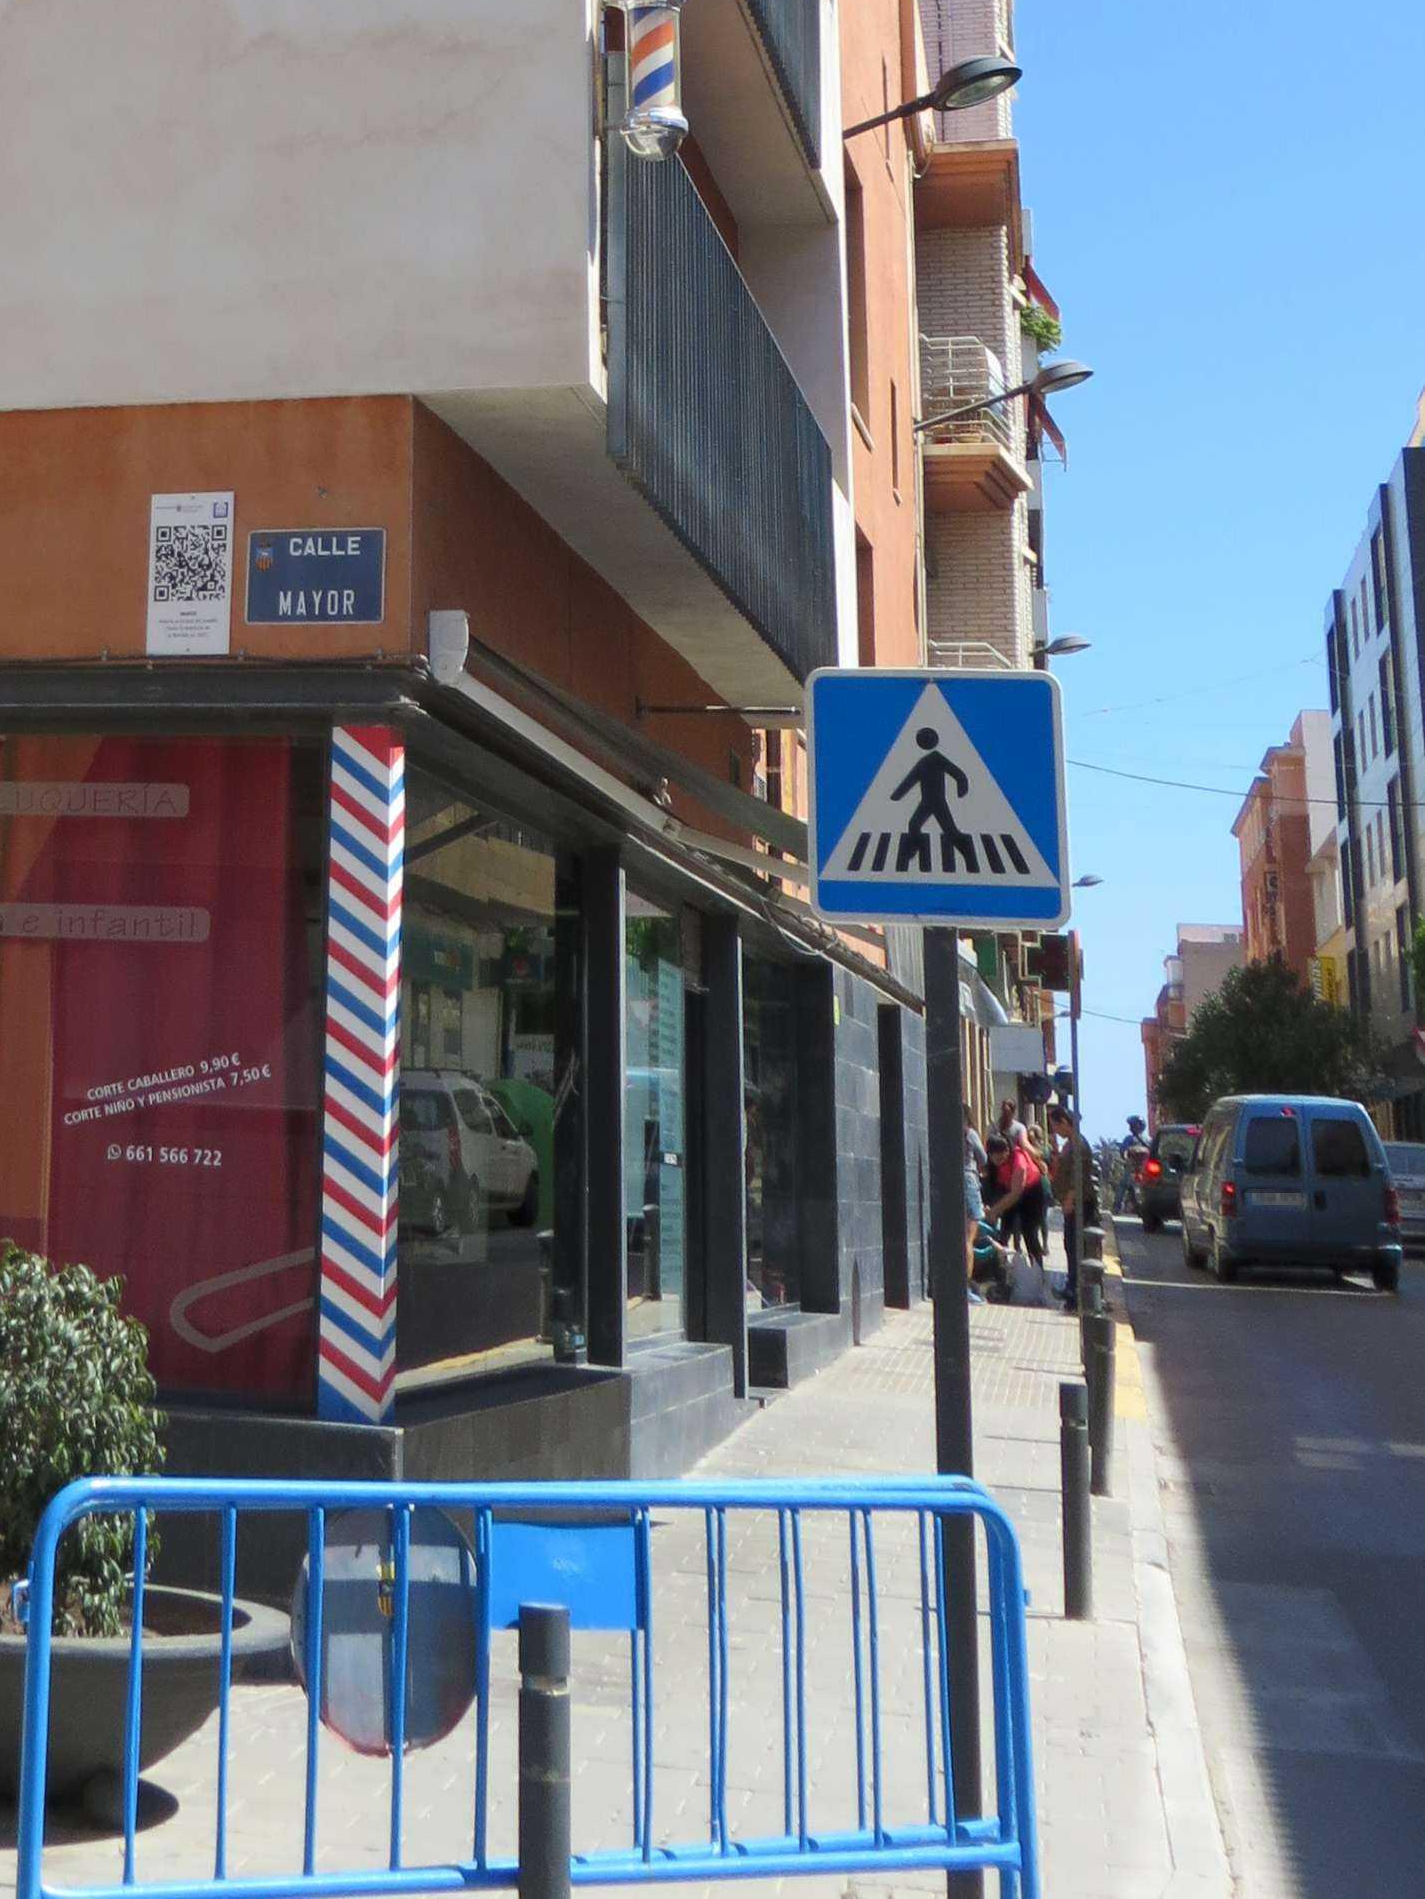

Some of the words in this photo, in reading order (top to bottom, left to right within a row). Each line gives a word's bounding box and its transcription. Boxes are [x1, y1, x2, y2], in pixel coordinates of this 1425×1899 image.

[289, 536, 362, 557] CALLE
[278, 590, 356, 616] MAYOR
[21, 914, 41, 933] e
[57, 910, 197, 940] infantil
[86, 1082, 125, 1101] CORTE
[127, 1064, 195, 1091] CABALLERO
[63, 1105, 102, 1126] CORTE
[148, 1076, 225, 1107] PENSIONISTA
[125, 1145, 154, 1163] 661
[159, 1147, 188, 1165] 566
[193, 1148, 222, 1167] 722
